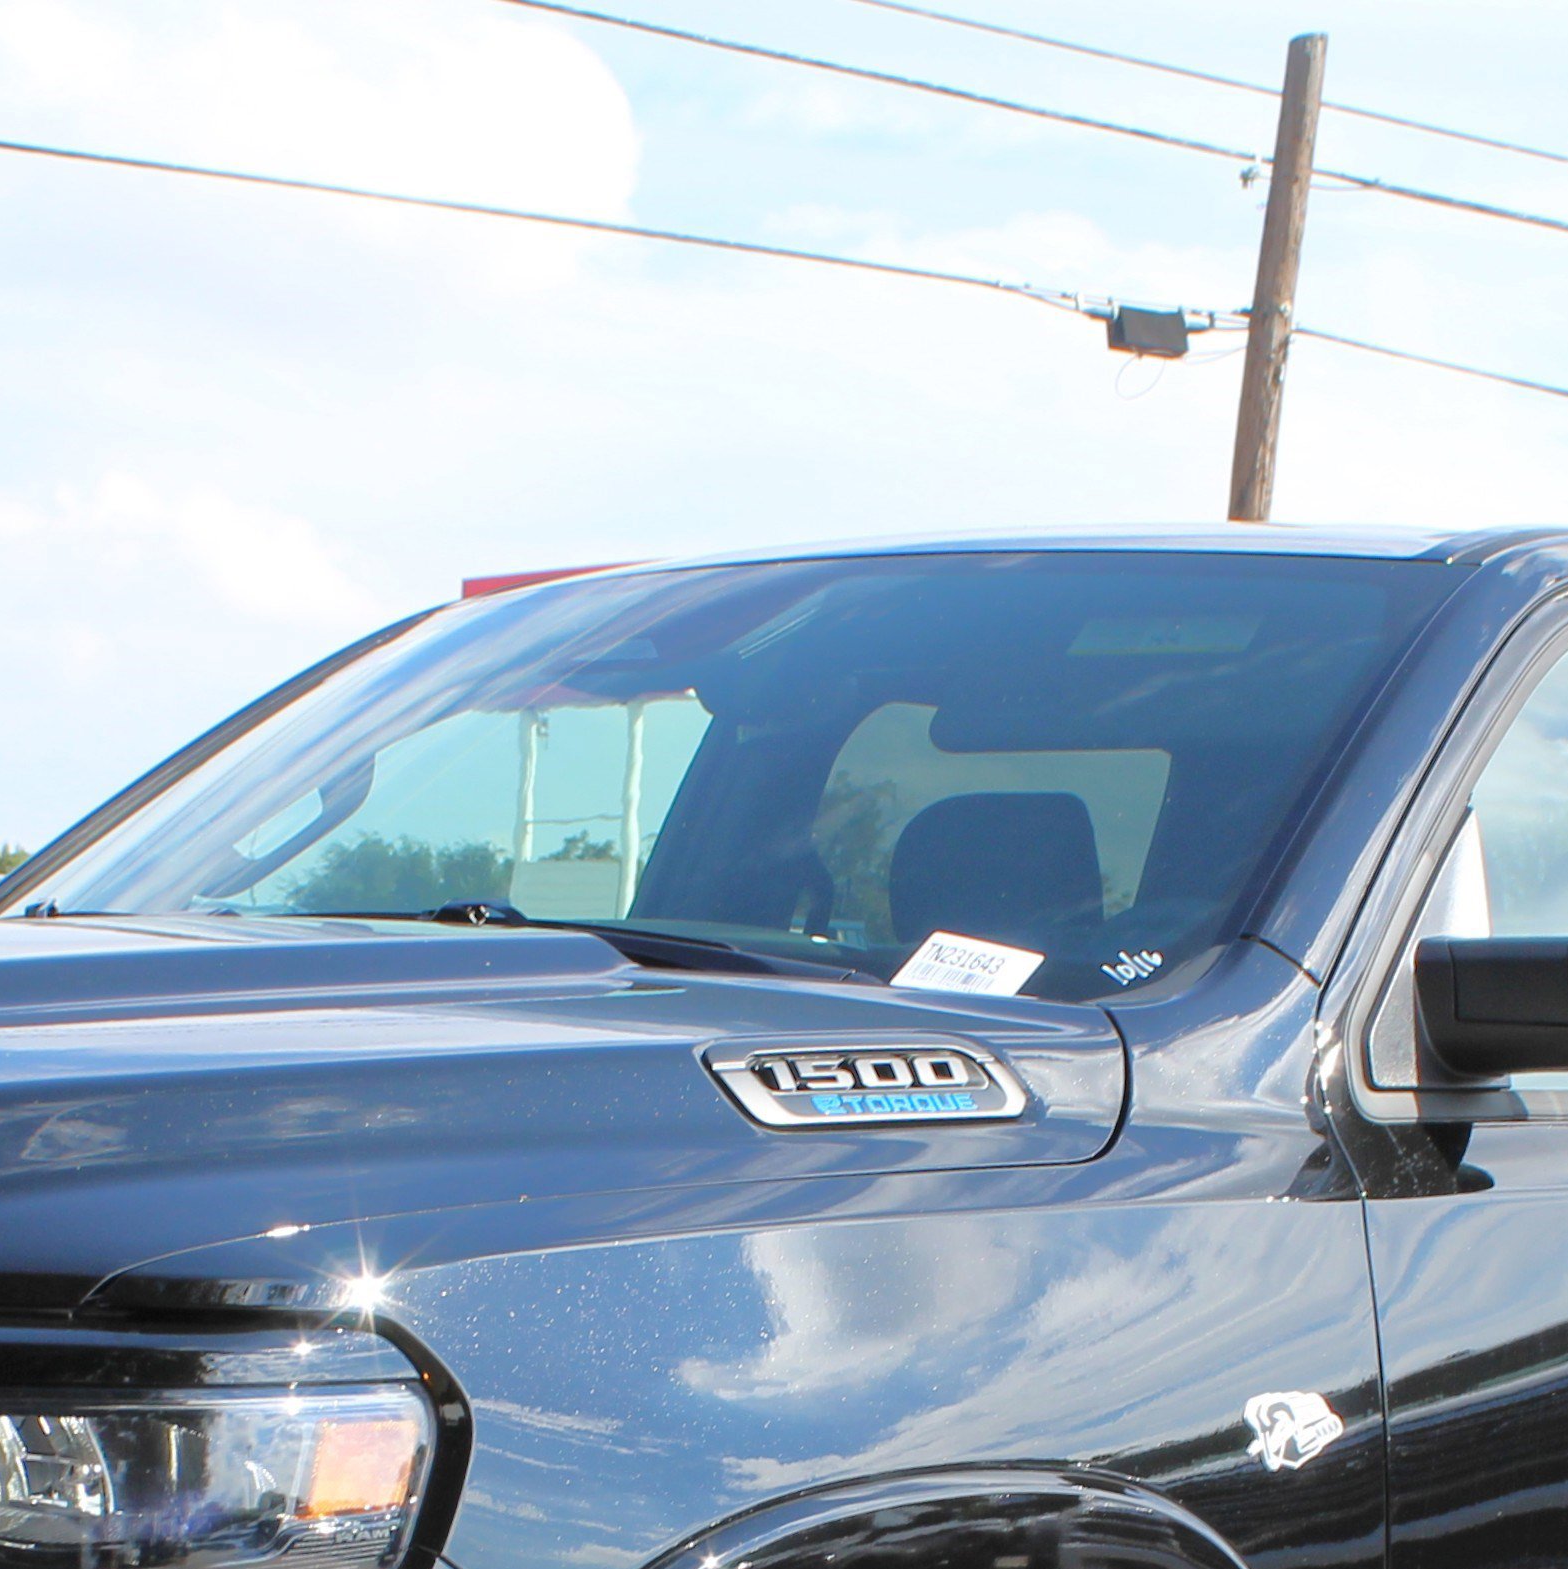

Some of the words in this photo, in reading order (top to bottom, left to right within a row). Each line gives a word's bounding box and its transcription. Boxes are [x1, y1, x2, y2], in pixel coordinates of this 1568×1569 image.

[921, 942, 1006, 975] TN231643
[763, 1056, 969, 1091] 1500
[335, 1528, 391, 1543] RAM
